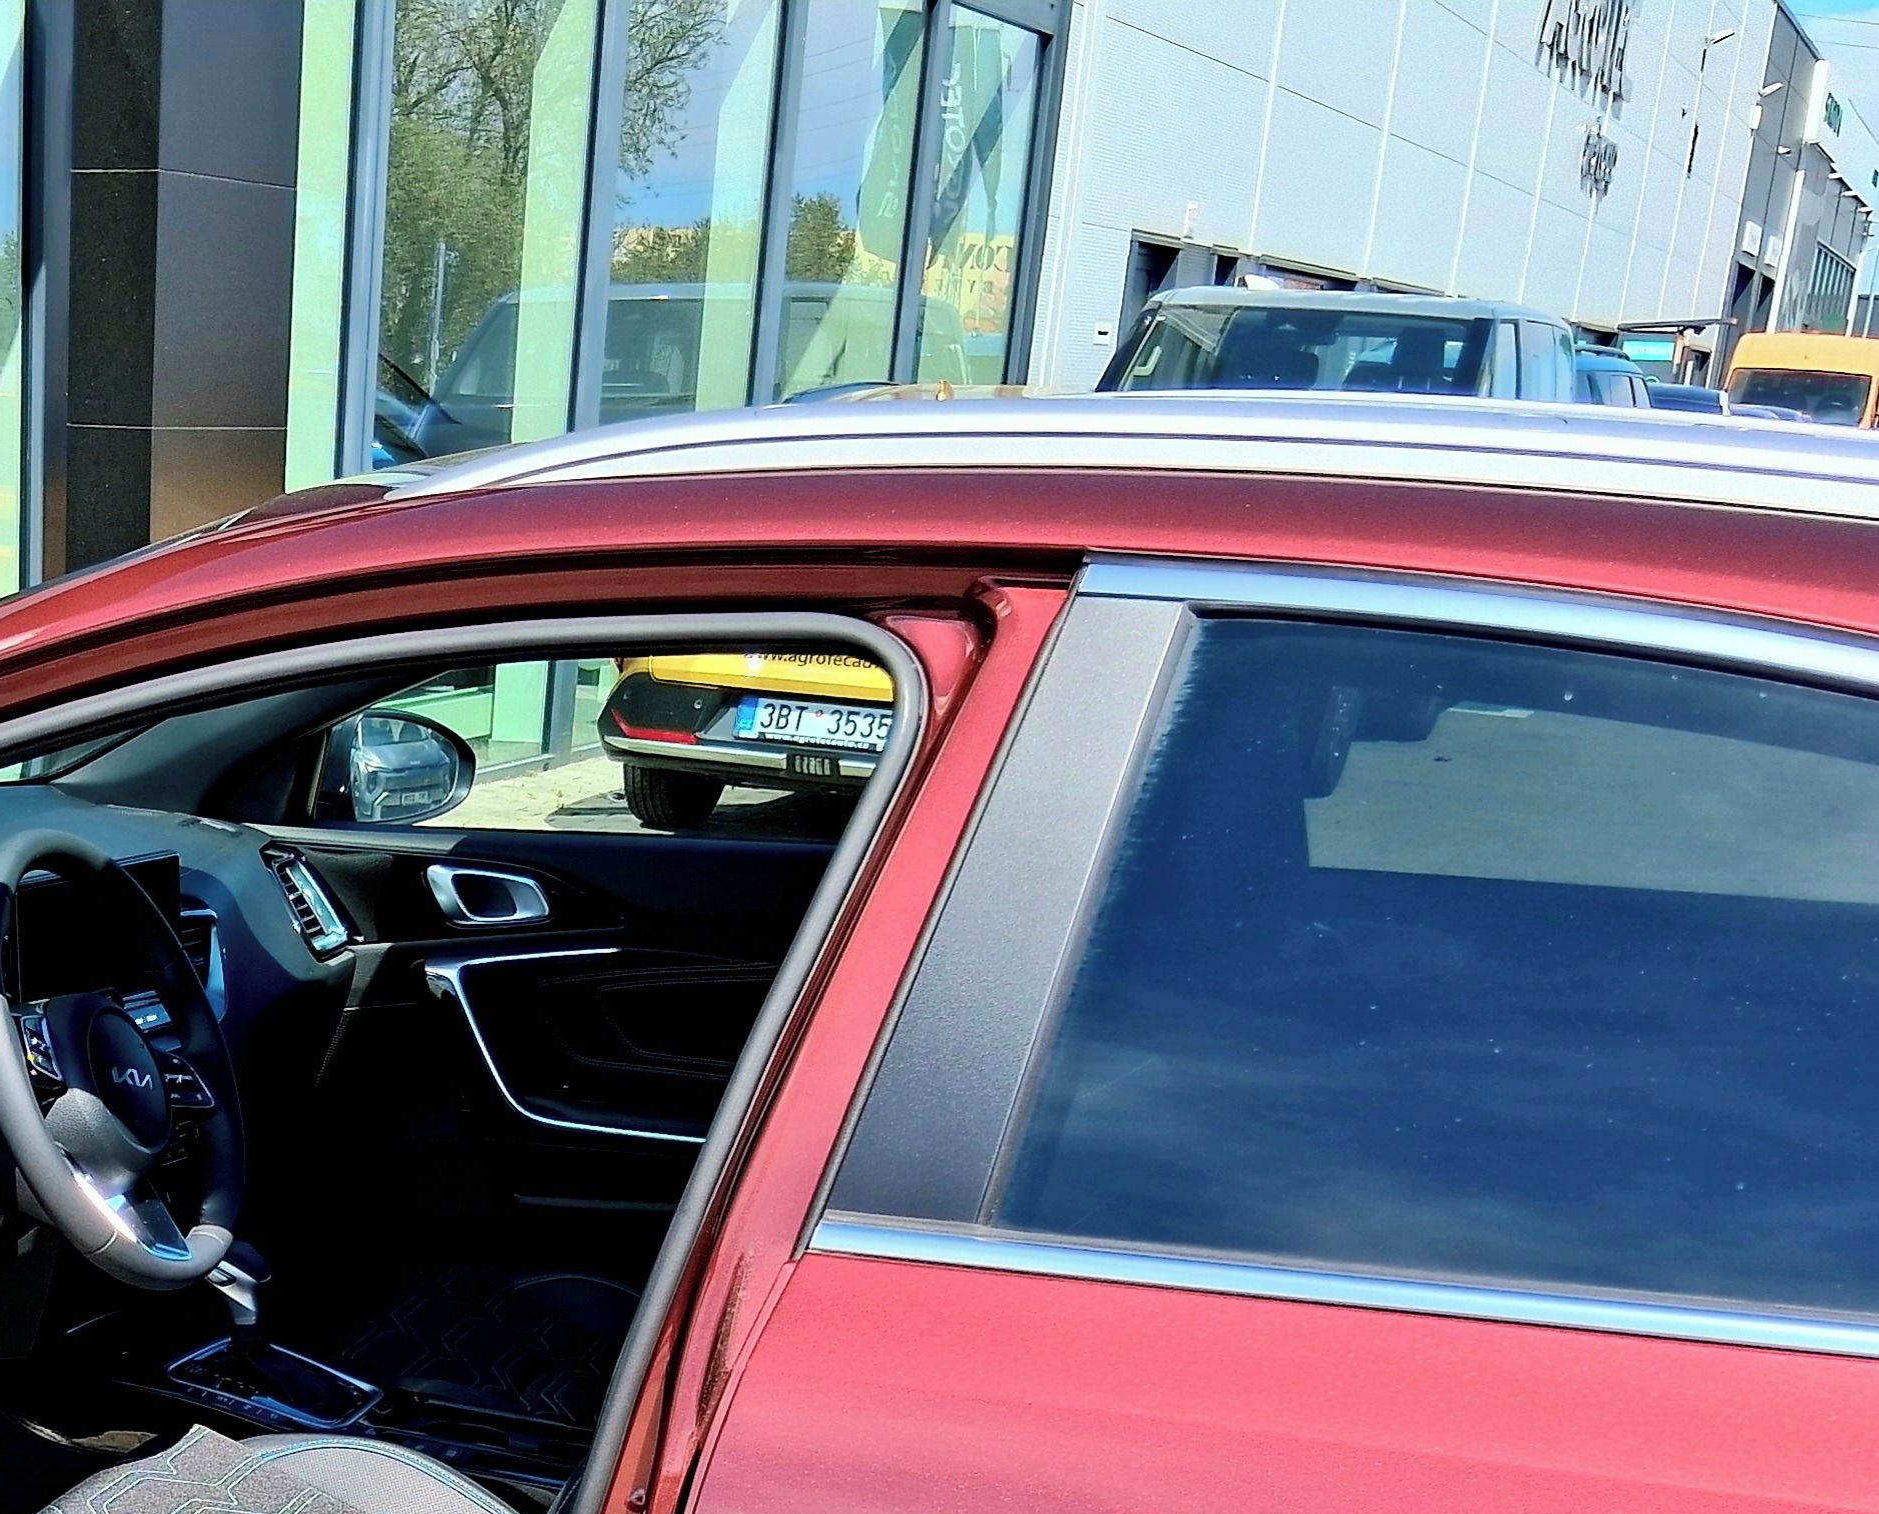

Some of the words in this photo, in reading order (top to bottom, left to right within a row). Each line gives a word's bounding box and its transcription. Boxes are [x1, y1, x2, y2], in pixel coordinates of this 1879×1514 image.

[760, 702, 809, 732] 3BT
[826, 709, 893, 740] 3535
[111, 1066, 154, 1091] KIA
